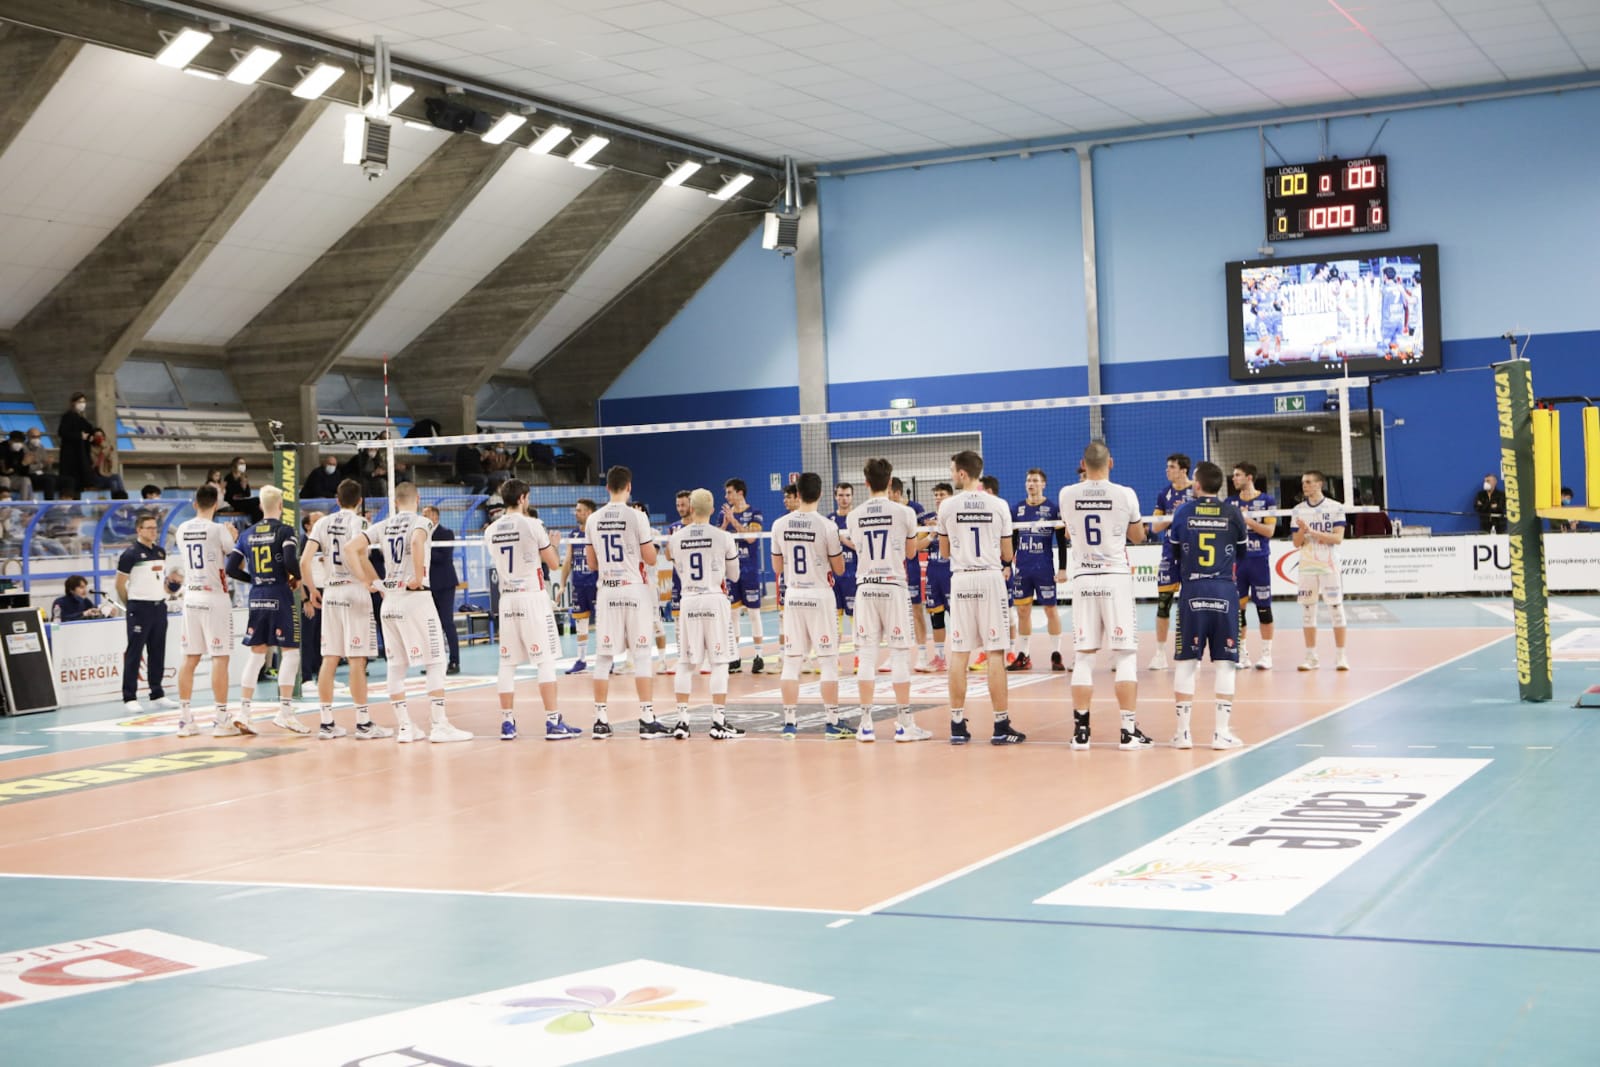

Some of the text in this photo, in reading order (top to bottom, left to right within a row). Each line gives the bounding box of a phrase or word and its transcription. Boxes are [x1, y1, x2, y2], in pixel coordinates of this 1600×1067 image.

[1279, 166, 1304, 175] LOCALI
[1281, 173, 1307, 196] 00
[1321, 175, 1330, 192] 0
[1348, 166, 1376, 189] 00
[1278, 216, 1287, 233] 0
[1372, 208, 1381, 224] 0
[1495, 373, 1514, 439] BANCA
[282, 450, 296, 502] BANCA
[1501, 448, 1520, 523] CREDEM
[970, 527, 980, 558] 1
[1084, 514, 1101, 546] 6
[187, 543, 204, 569] 13
[251, 545, 273, 574] 12
[332, 538, 342, 566] 2
[388, 536, 404, 564] 10
[500, 546, 514, 574] 7
[602, 534, 623, 563] 15
[794, 545, 807, 575] 8
[864, 530, 888, 561] 17
[1198, 533, 1216, 567] 5
[690, 552, 703, 581] 9
[1510, 534, 1526, 602] BANCA
[61, 653, 120, 669] ANTENORE
[1514, 609, 1531, 685] CREDEM
[60, 665, 120, 683] ENERGIA
[0, 751, 249, 802] CRED
